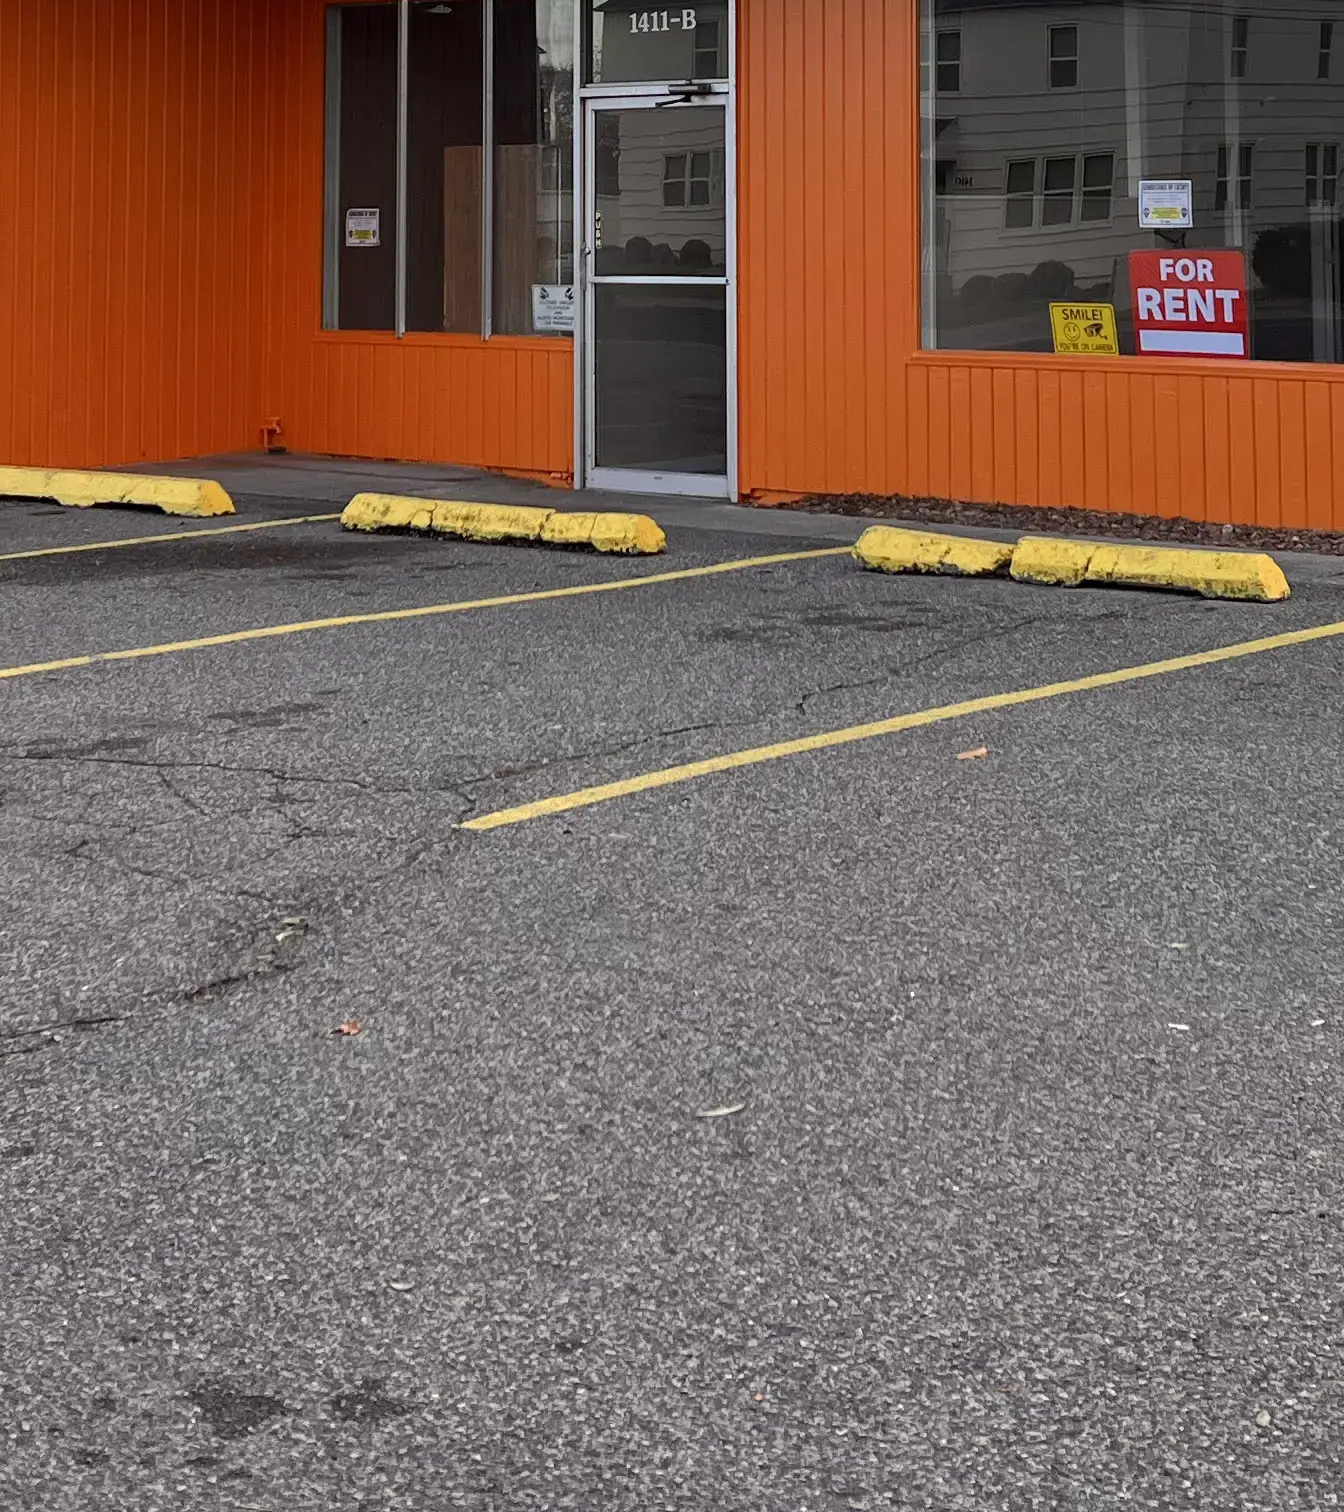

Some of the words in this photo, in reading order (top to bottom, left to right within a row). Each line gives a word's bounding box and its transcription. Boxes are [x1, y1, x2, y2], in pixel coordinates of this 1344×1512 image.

[629, 8, 697, 34] 1411-B
[1159, 258, 1214, 282] FOR
[1061, 309, 1104, 321] SMILE!
[1137, 287, 1240, 323] RENT
[1091, 343, 1114, 352] CAMERA
